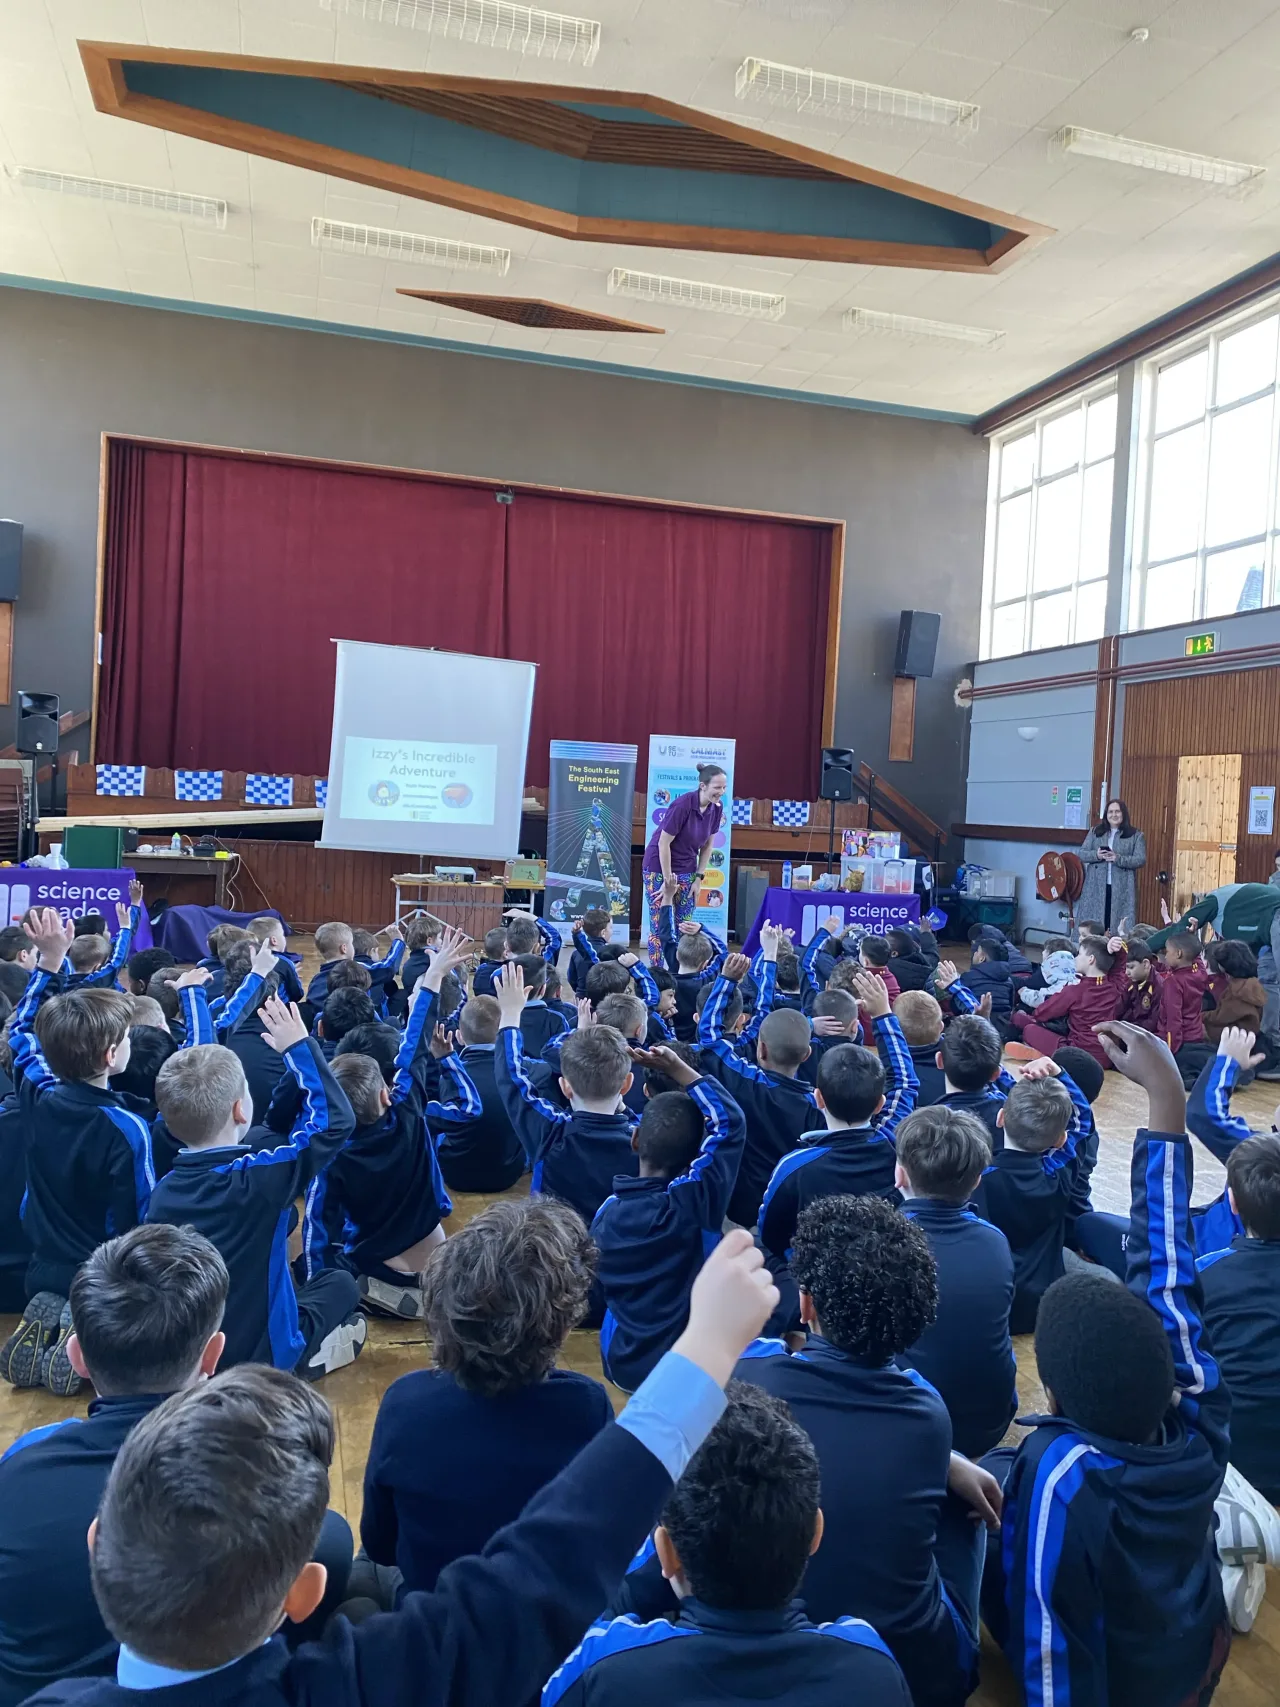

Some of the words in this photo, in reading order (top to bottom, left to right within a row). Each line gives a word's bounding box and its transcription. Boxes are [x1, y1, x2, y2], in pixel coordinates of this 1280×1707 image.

[371, 748, 408, 761] Izzy's
[412, 751, 476, 764] Incredible
[390, 765, 456, 778] Adventure
[568, 765, 582, 773] The
[583, 766, 603, 774] South
[604, 767, 620, 775] East
[568, 774, 619, 785] Engineering
[577, 784, 612, 793] Festival
[37, 881, 121, 900] science
[46, 901, 101, 919] ade
[849, 902, 909, 919] science
